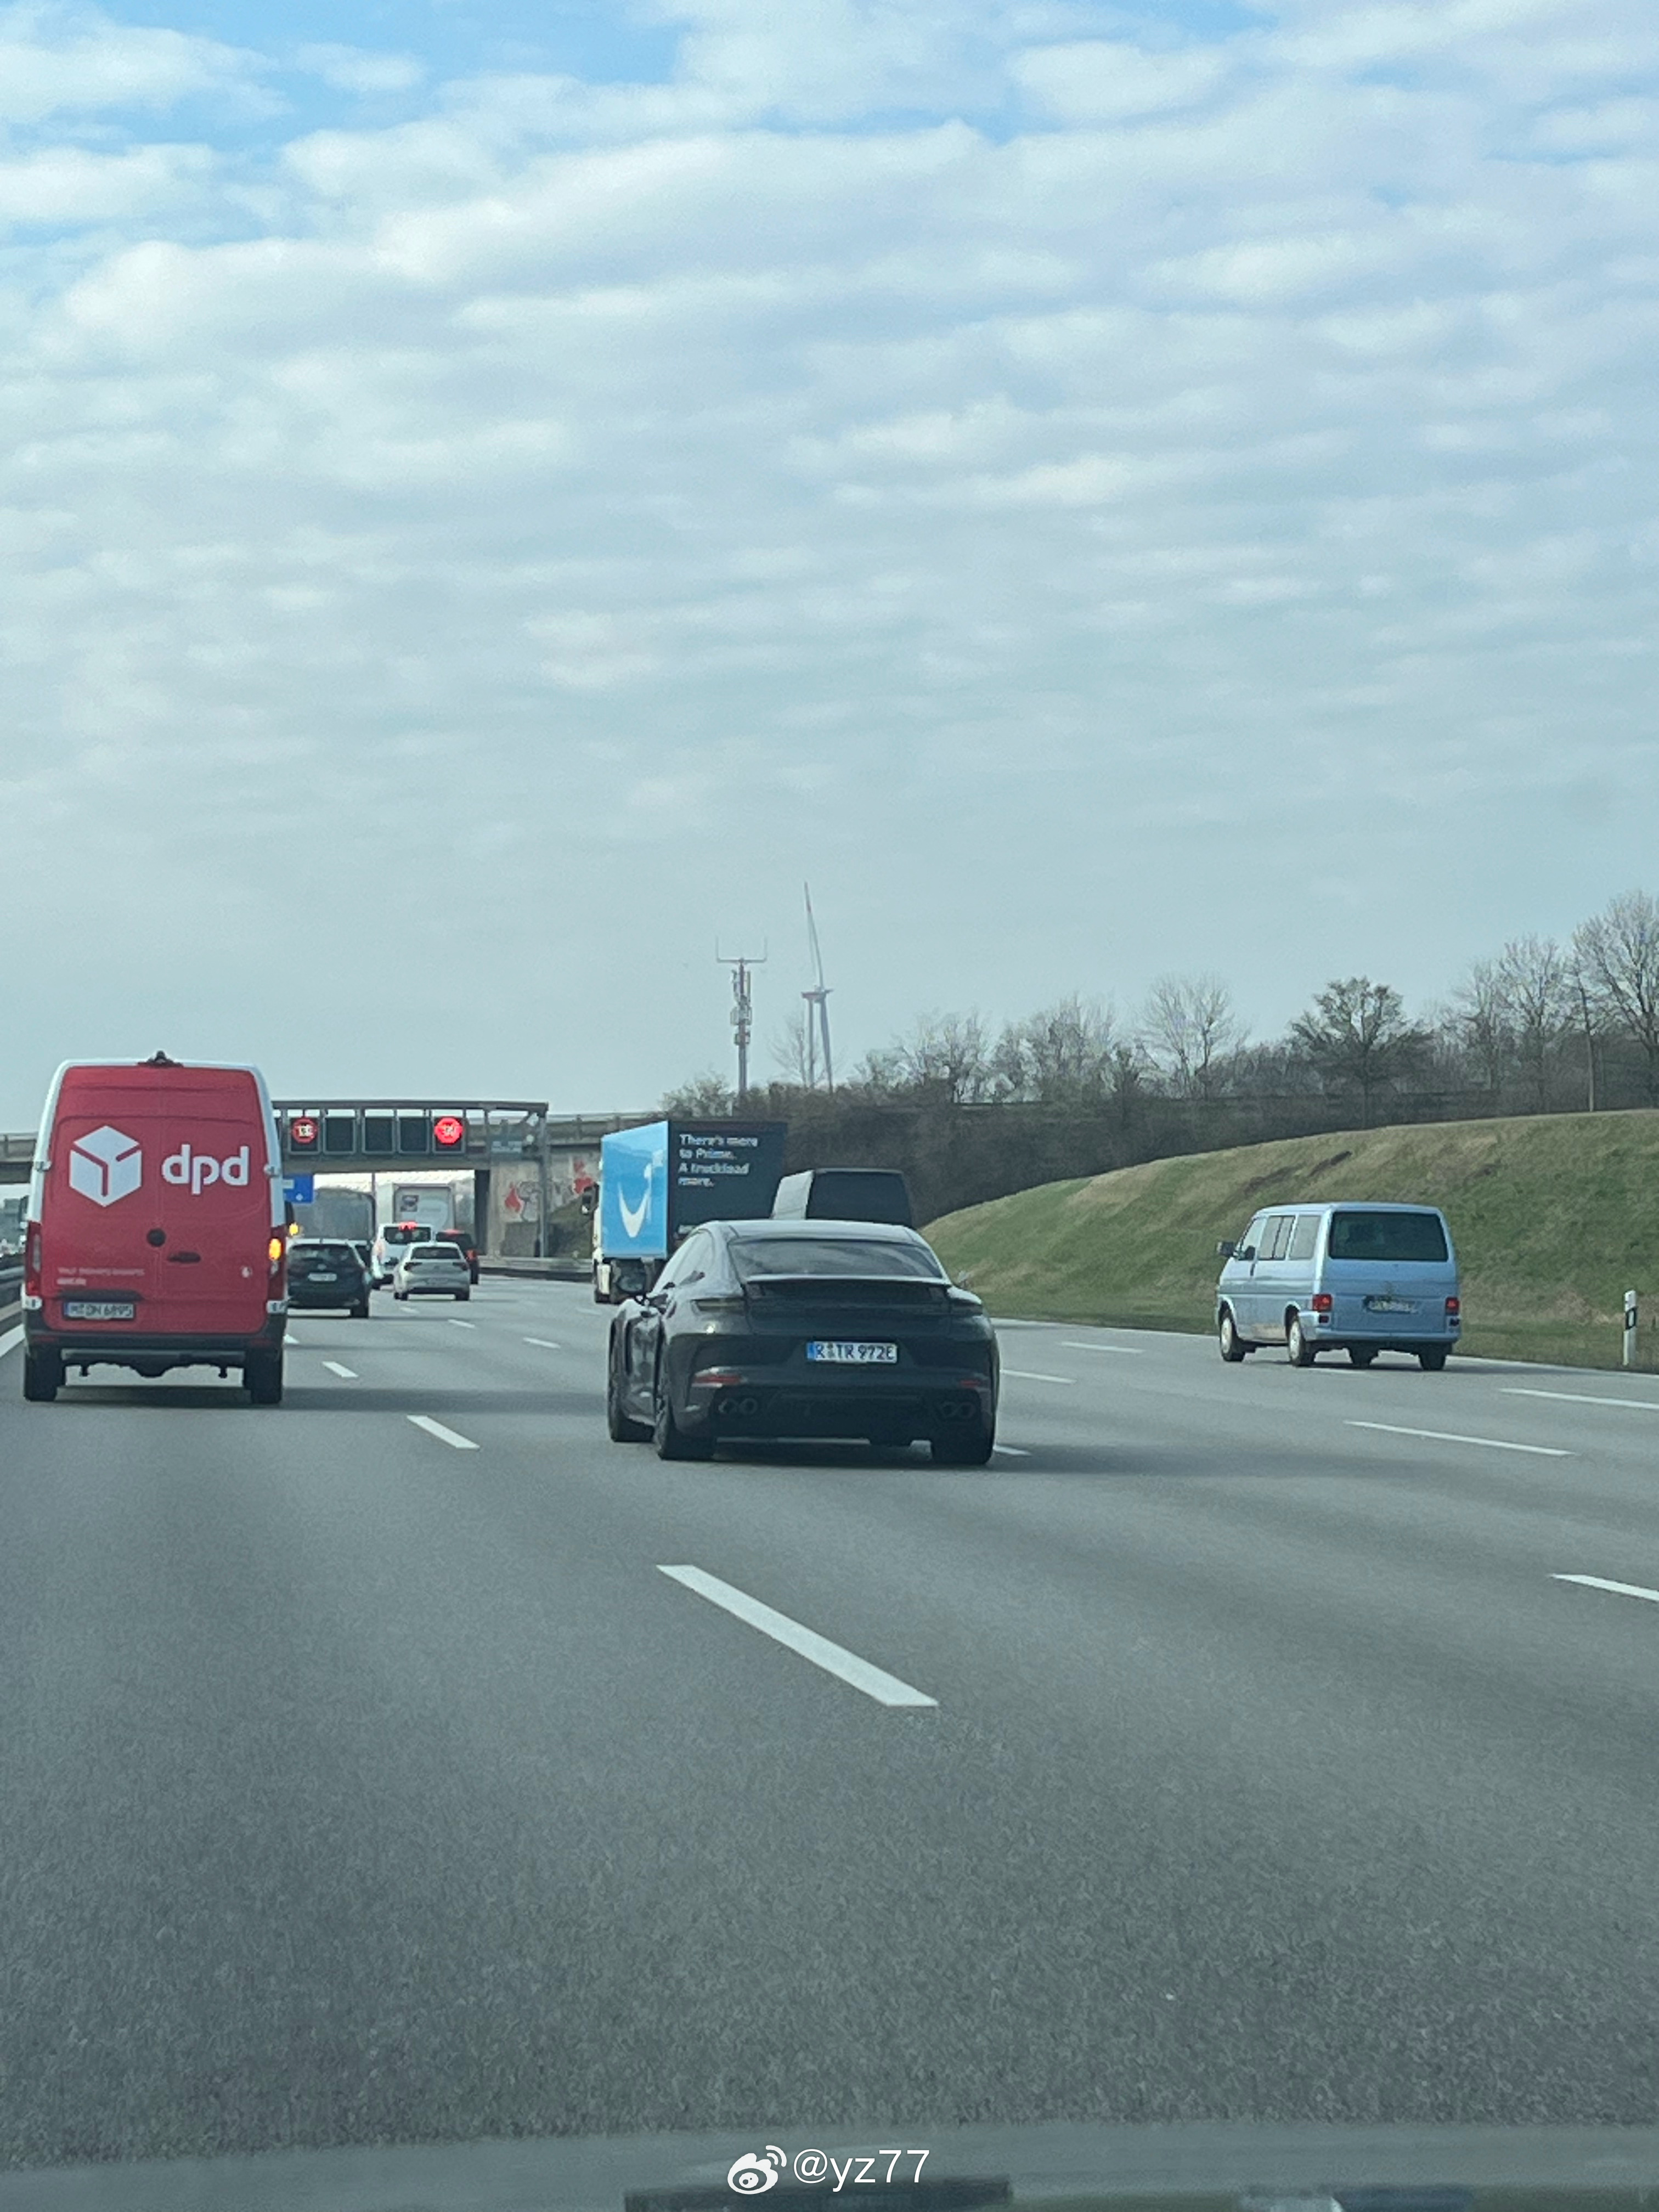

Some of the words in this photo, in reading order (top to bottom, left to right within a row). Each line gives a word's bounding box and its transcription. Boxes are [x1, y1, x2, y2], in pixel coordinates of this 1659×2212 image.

[679, 1134, 724, 1146] There's
[726, 1137, 758, 1147] more
[679, 1148, 692, 1159] to
[161, 1144, 250, 1195] dpd
[678, 1163, 689, 1173] A
[691, 1163, 750, 1174] truckload
[816, 1345, 825, 1358] R
[837, 1345, 854, 1359] TR
